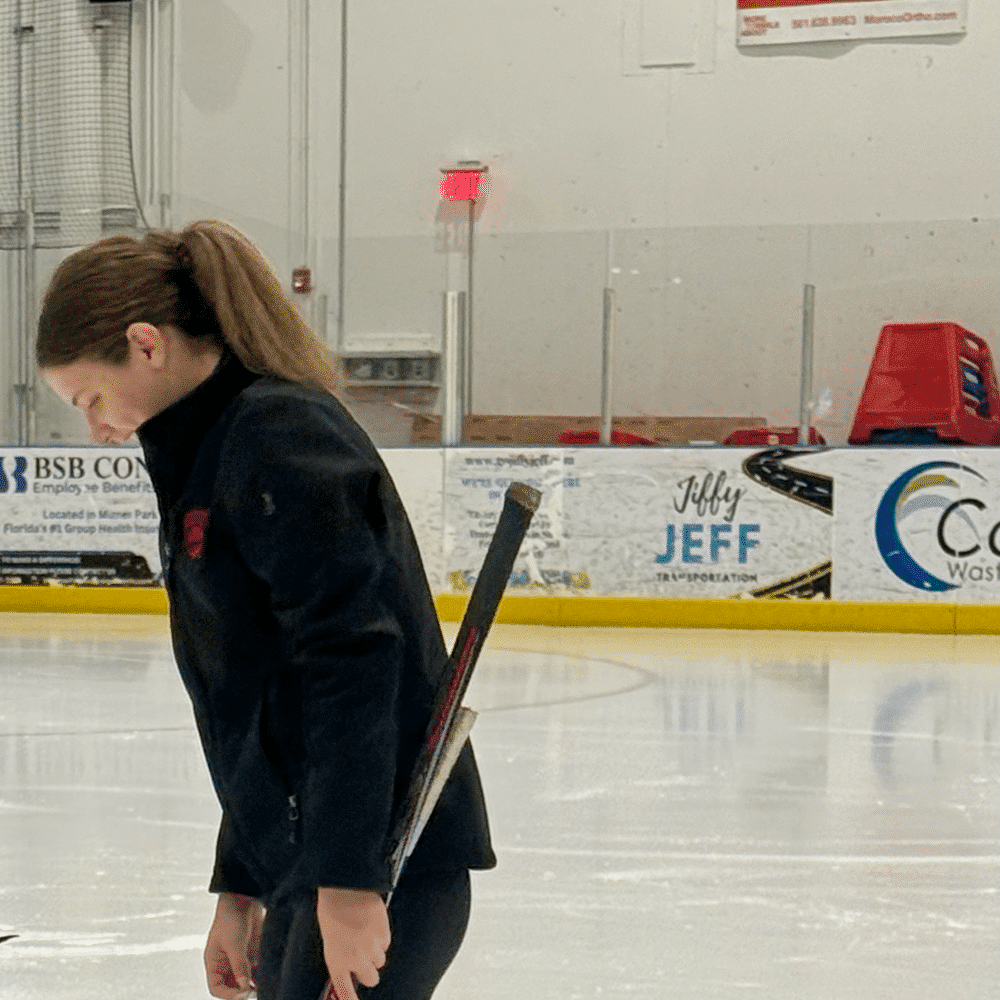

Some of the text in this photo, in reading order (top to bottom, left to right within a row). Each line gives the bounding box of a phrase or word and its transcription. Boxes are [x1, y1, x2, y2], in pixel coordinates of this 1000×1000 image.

[34, 456, 85, 479] BSB
[673, 470, 748, 522] Jiffy
[134, 509, 157, 519] Park
[64, 523, 97, 535] Group
[654, 523, 761, 564] JEFF
